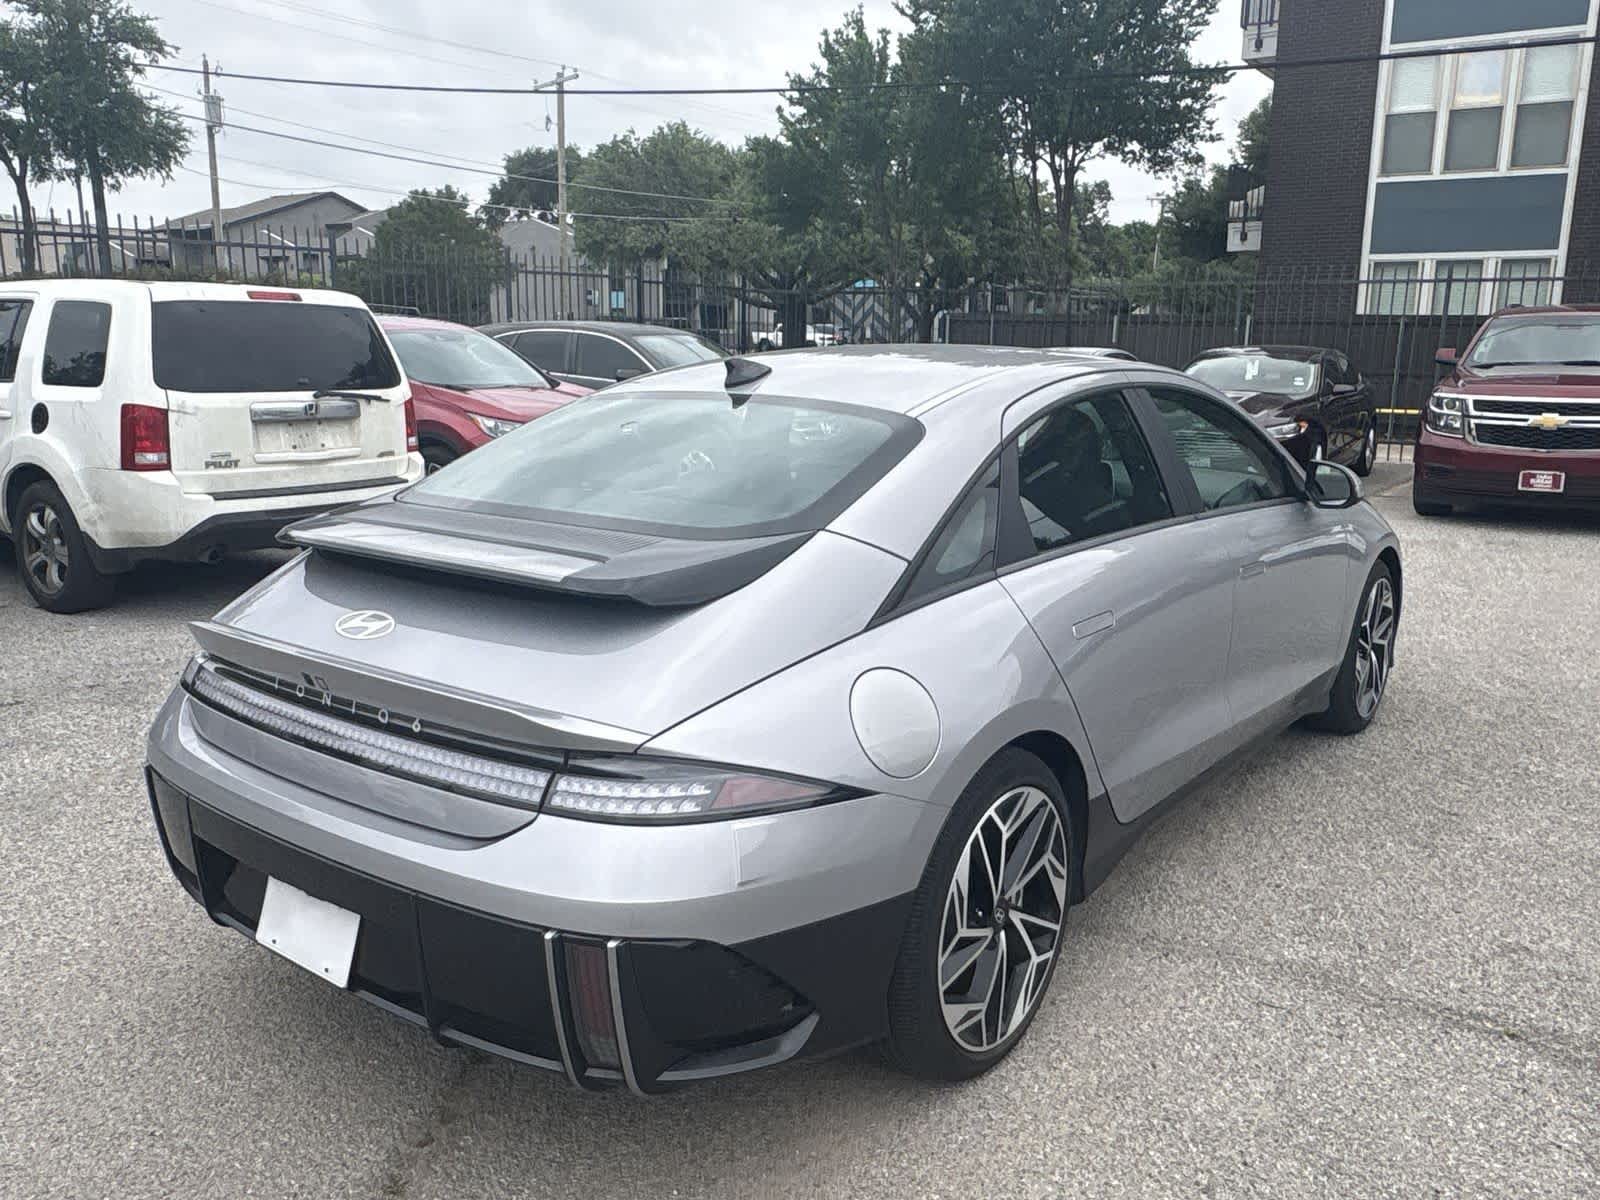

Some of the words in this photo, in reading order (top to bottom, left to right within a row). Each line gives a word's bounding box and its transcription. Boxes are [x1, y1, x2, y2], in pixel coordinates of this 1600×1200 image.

[204, 459, 240, 470] PILOT
[275, 676, 389, 724] IONIQ
[411, 717, 422, 733] 6
